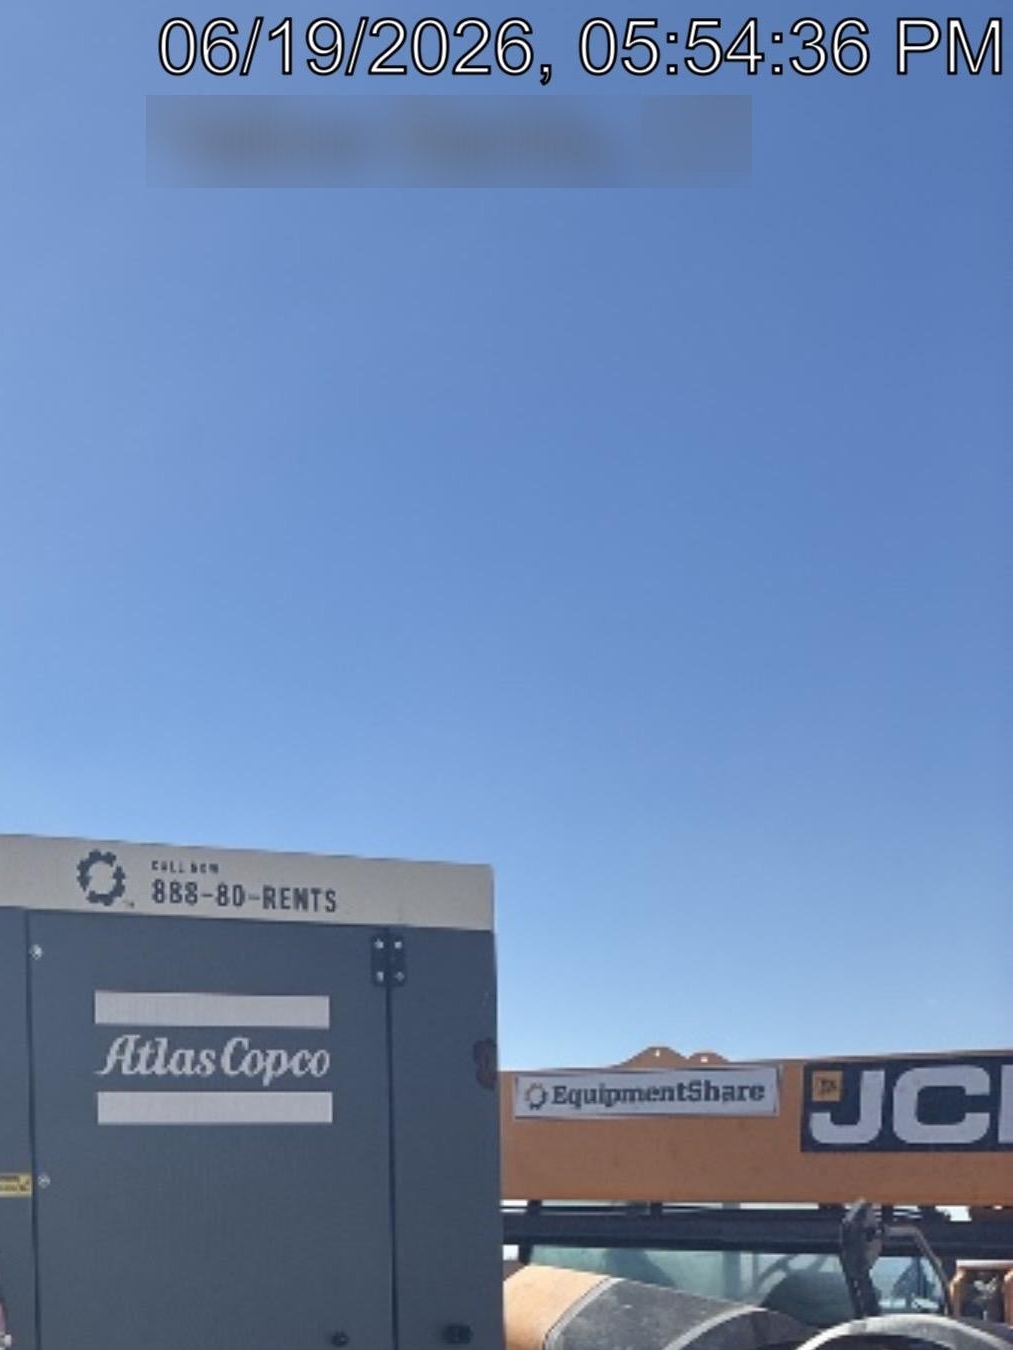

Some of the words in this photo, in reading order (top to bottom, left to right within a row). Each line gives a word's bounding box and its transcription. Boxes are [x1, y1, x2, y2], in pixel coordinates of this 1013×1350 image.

[151, 878, 337, 913] 888-80-RENTS
[551, 1080, 765, 1110] EquipmentShare
[809, 1065, 1013, 1144] JC
